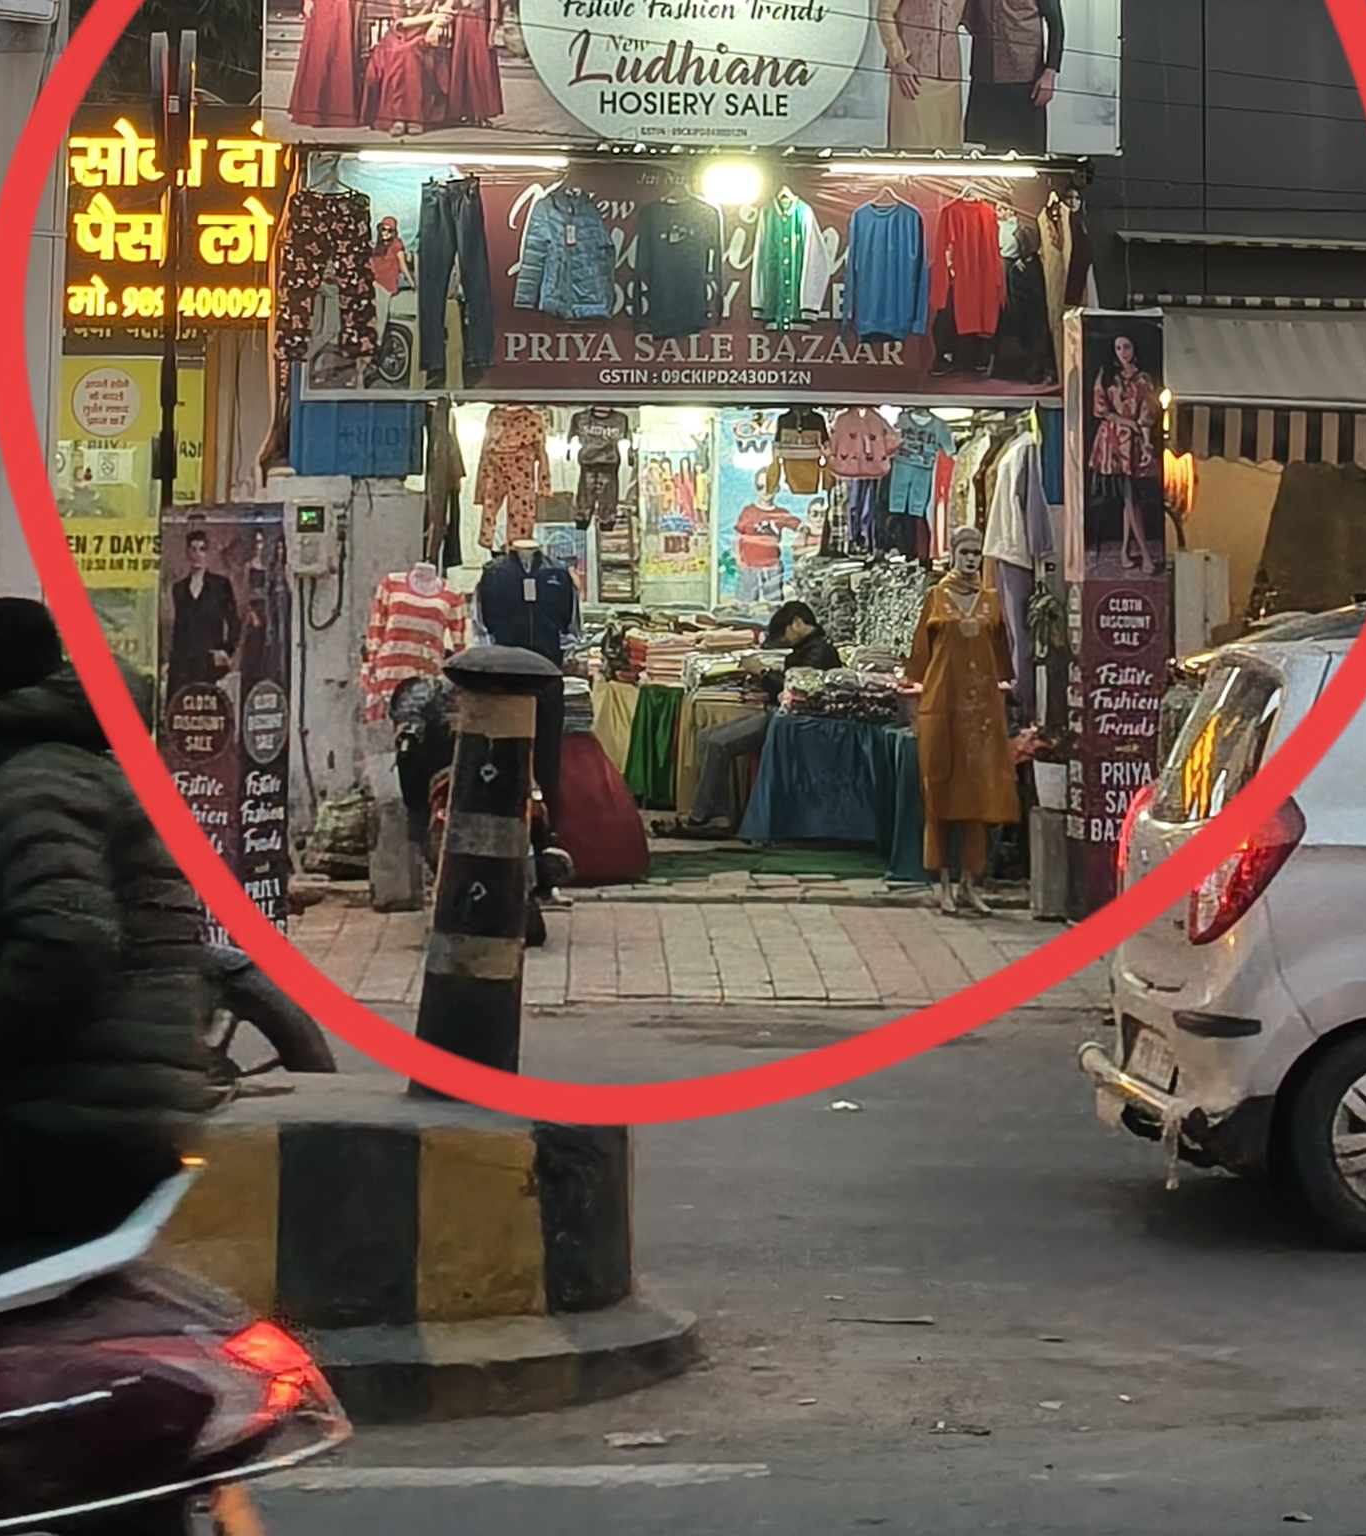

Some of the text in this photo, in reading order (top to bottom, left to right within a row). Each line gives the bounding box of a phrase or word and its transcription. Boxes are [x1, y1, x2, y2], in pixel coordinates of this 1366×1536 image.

[606, 34, 649, 53] New
[568, 29, 819, 88] Ludhiana
[600, 90, 789, 117] HOSIERY SALE
[197, 195, 275, 265] लो
[67, 273, 118, 317] मो.
[504, 332, 904, 366] PRIYA SALE BAZAAR
[599, 369, 649, 385] GSTIN
[94, 534, 105, 554] 7
[1108, 597, 1143, 612] CLOTH
[1099, 614, 1152, 630] DISCOUNT
[1112, 631, 1140, 646] SALE
[1095, 662, 1154, 686] Festive
[172, 715, 225, 731] DISCOUNT
[1095, 713, 1157, 736] Trends
[185, 735, 214, 752] SALE
[1100, 761, 1153, 785] PRIYA
